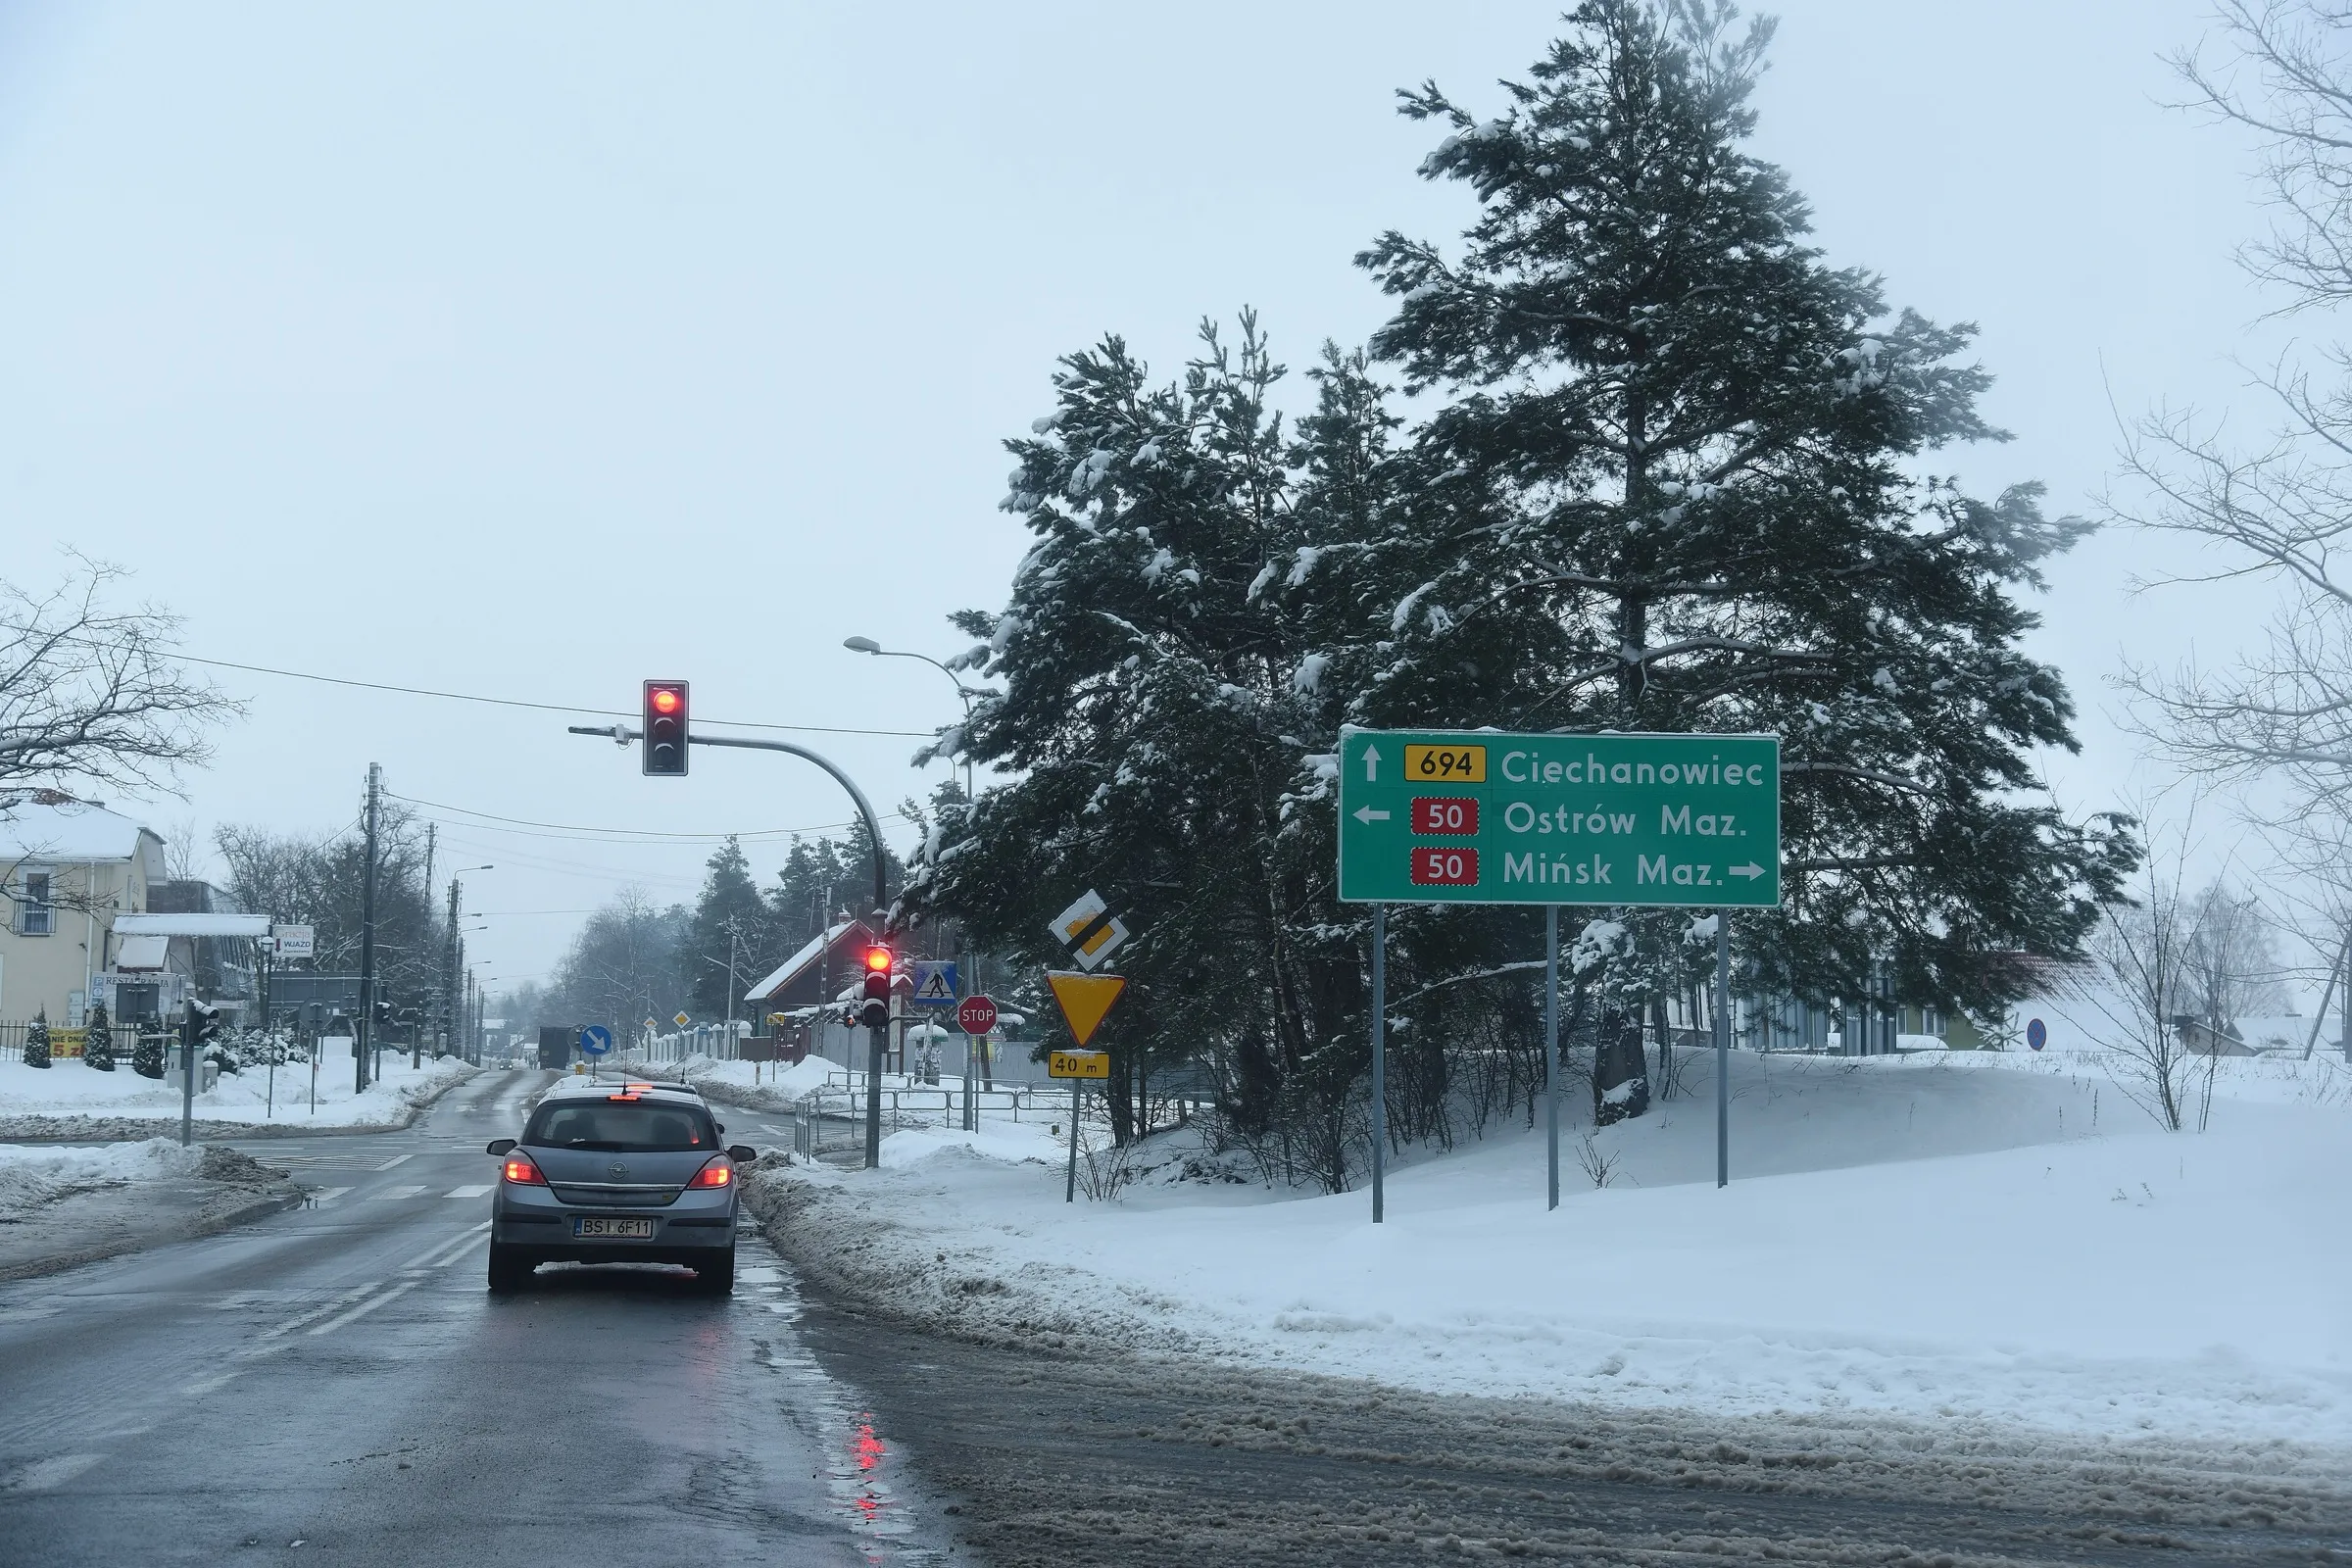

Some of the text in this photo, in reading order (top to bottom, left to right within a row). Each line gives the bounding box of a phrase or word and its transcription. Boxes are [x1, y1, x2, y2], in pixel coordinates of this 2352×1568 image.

[1420, 751, 1764, 786] 694 Ciechanowiec
[1428, 802, 1746, 836] 50 Ostrów Maz.
[1428, 852, 1723, 886] 50 Mińsk Maz.
[962, 1009, 994, 1021] STOP
[1055, 1057, 1097, 1073] 40 m
[584, 1220, 611, 1234] BSI
[617, 1220, 649, 1234] 6F11
